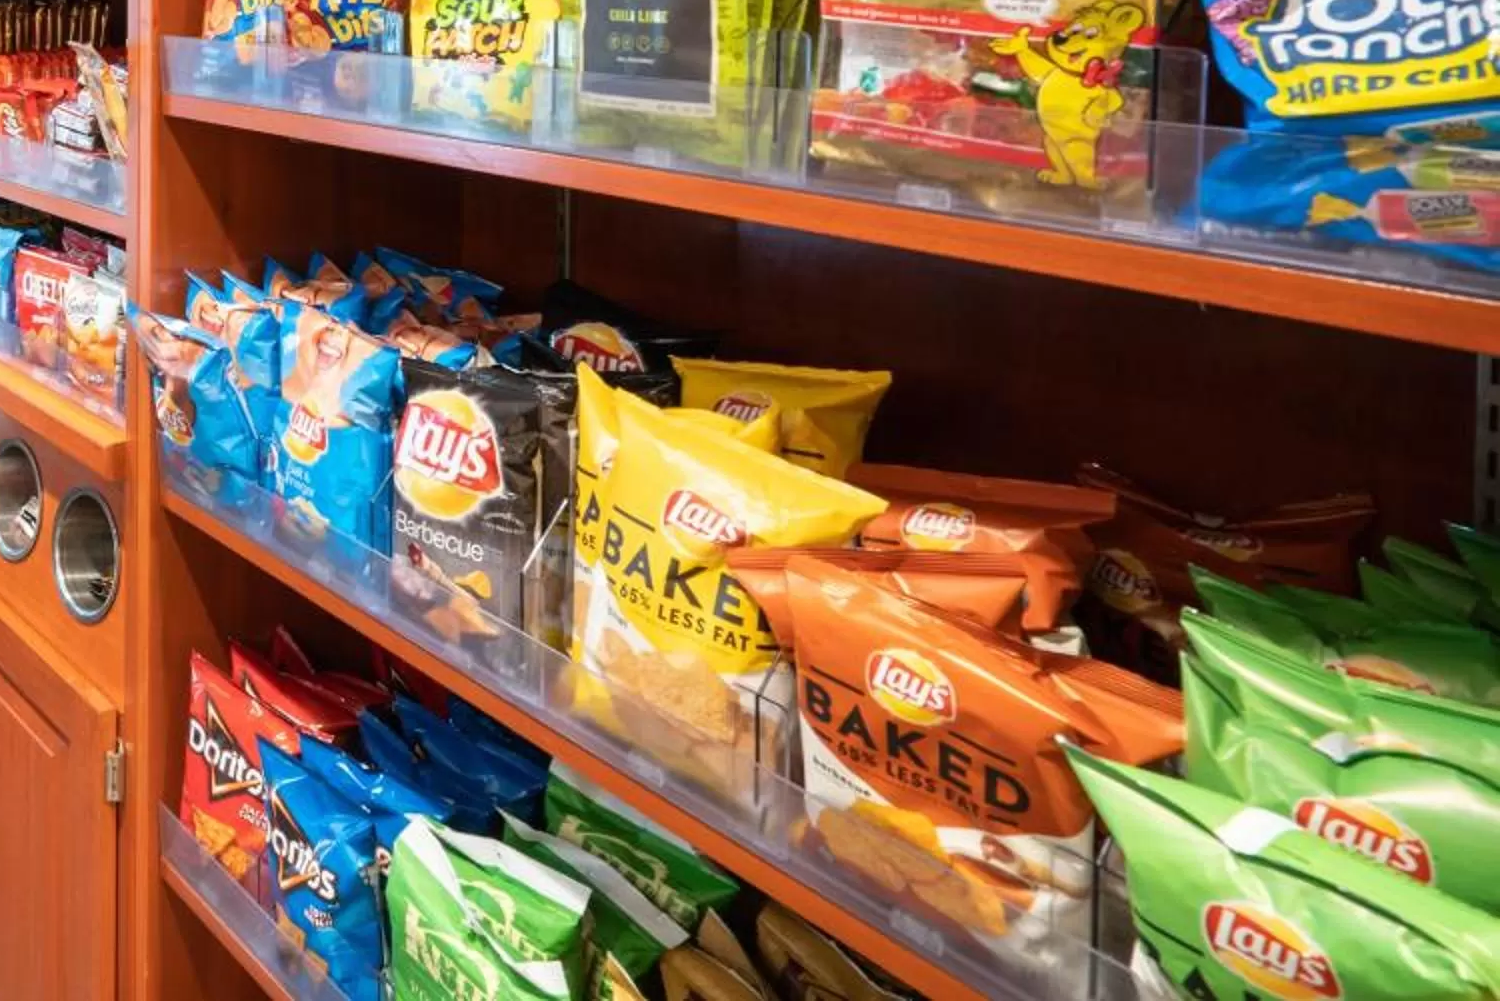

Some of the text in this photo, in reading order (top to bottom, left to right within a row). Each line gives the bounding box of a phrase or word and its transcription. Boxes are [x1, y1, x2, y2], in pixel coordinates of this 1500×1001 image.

[1285, 74, 1396, 105] HARD
[397, 404, 495, 482] Lay's
[395, 510, 484, 562] Barbecue
[904, 505, 972, 538] Lay's
[619, 583, 651, 612] 65%
[657, 605, 706, 635] LESS
[713, 626, 751, 652] FAT
[871, 653, 953, 712] Lay's
[189, 718, 267, 799] Dorito
[804, 676, 1032, 814] BAKED
[812, 755, 872, 798] barbecue
[885, 759, 937, 794] LESS
[1298, 802, 1421, 874] Lay's
[1212, 905, 1328, 987] Lay's
